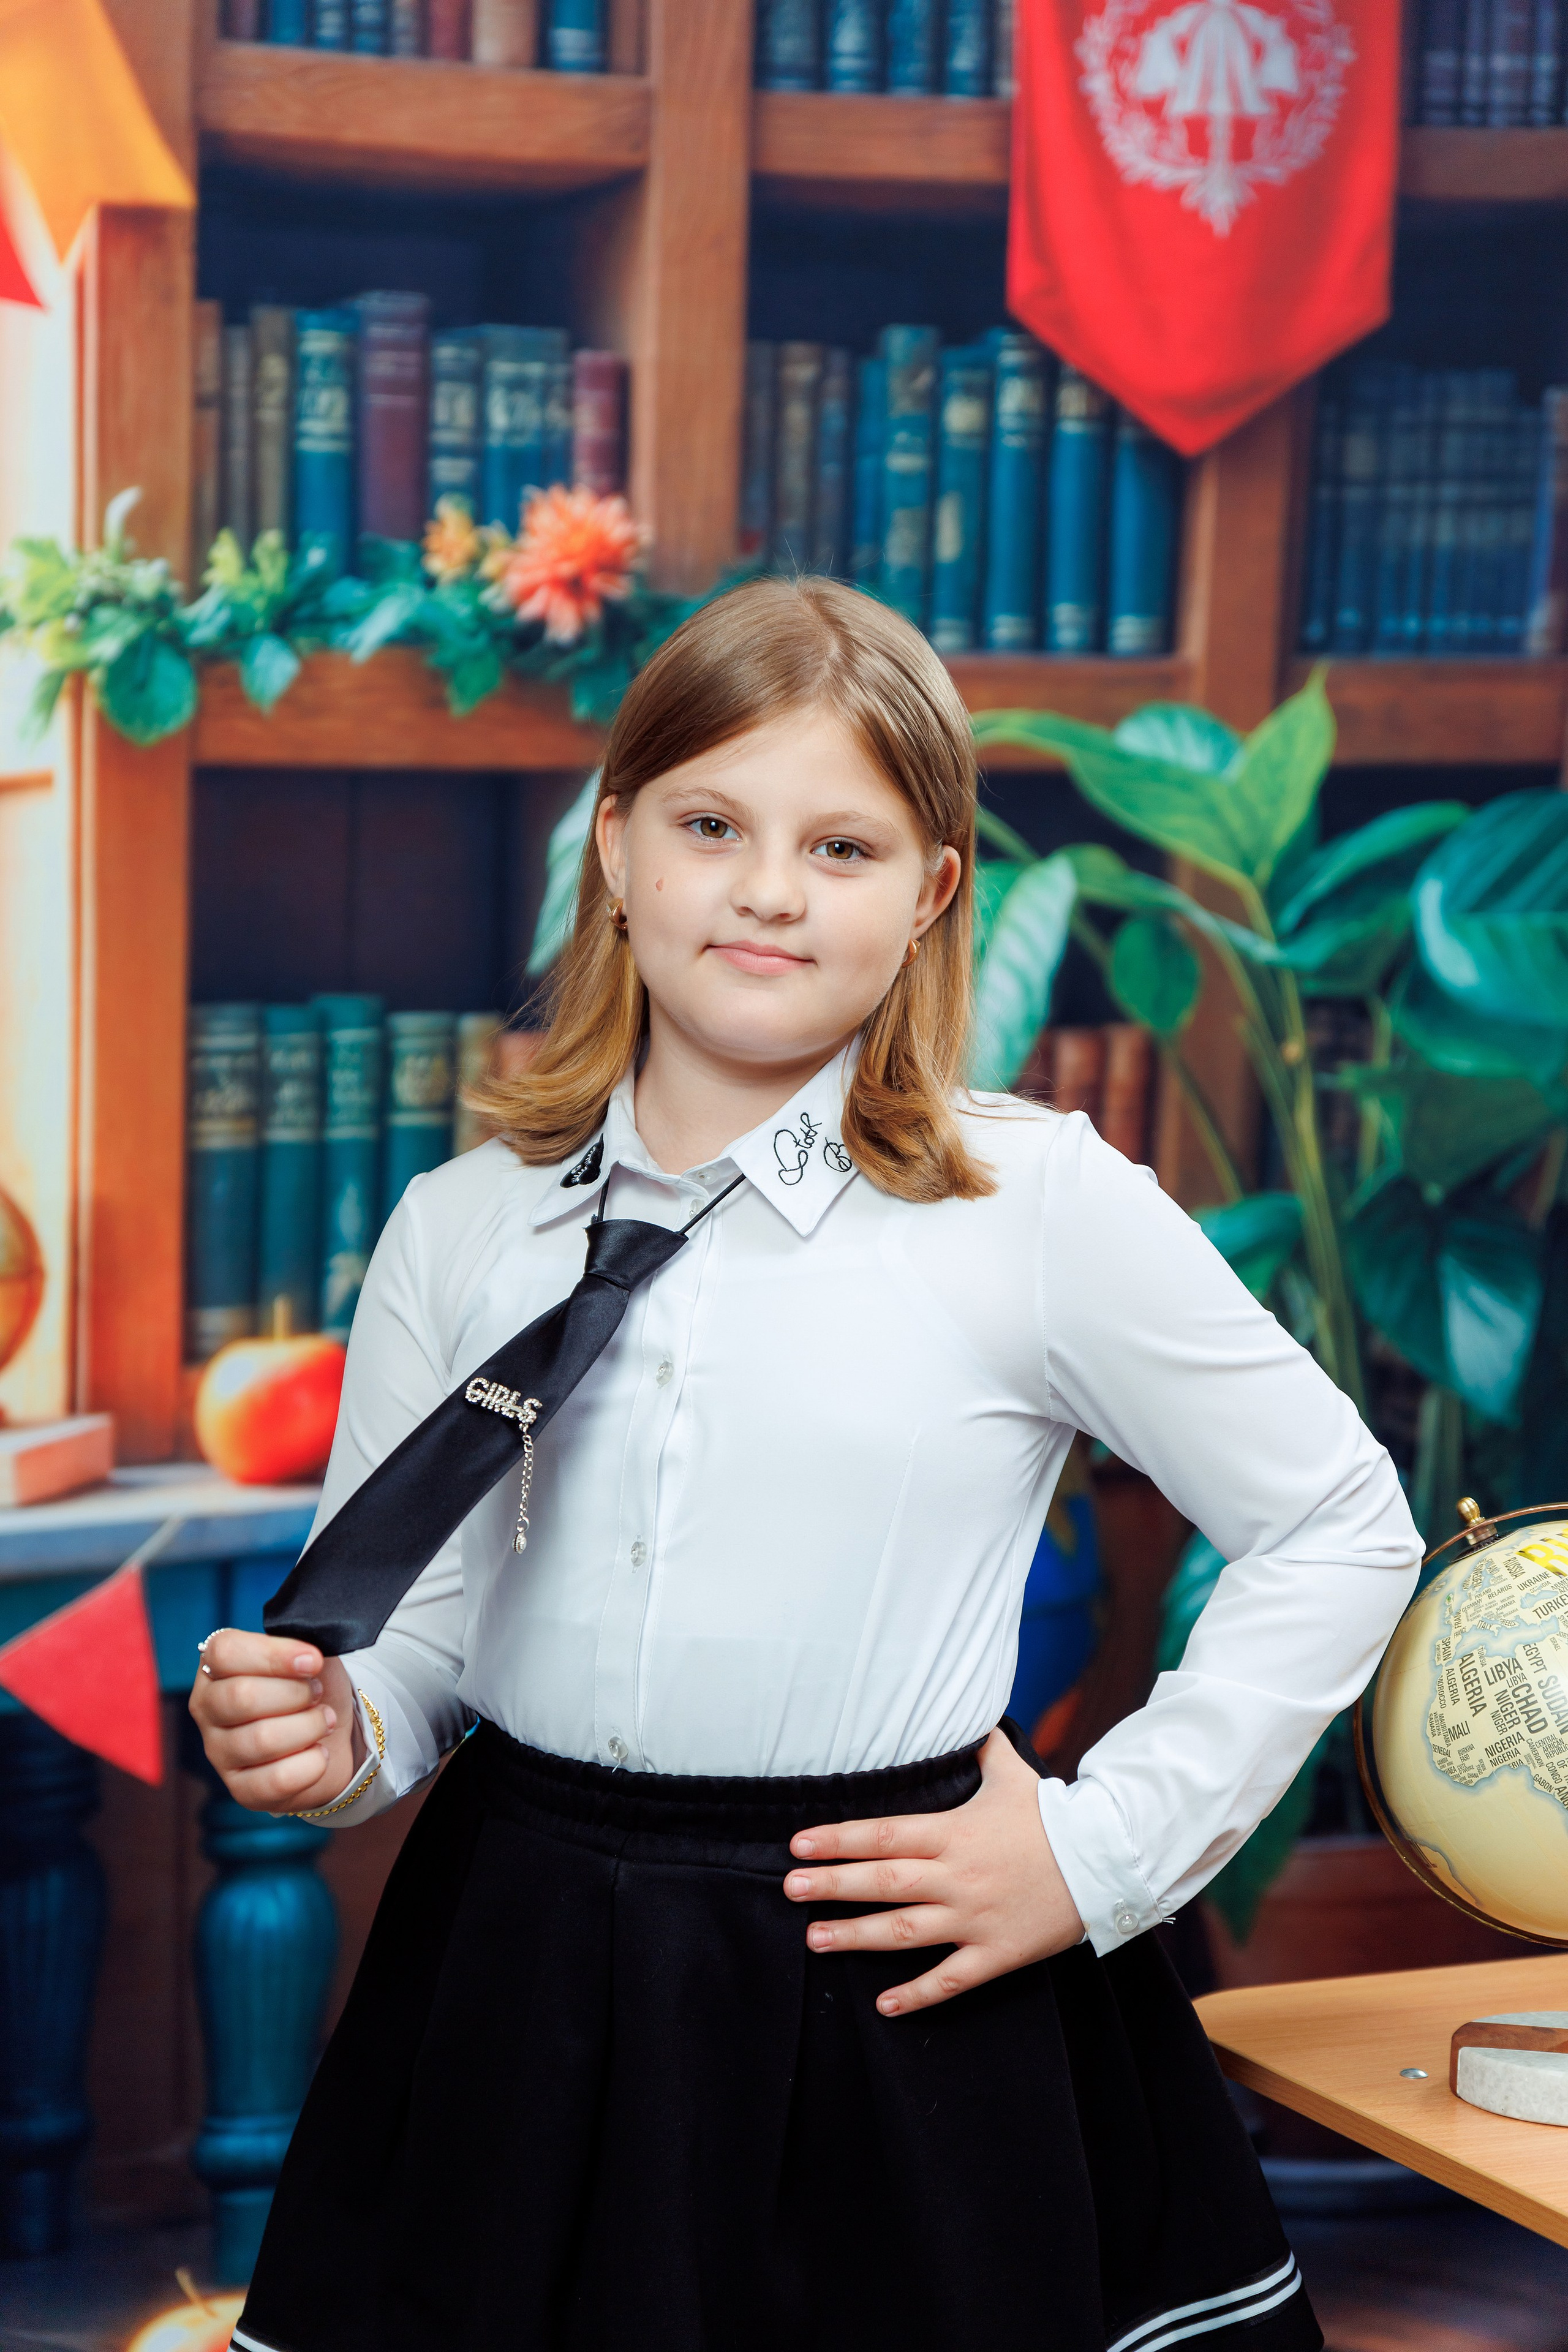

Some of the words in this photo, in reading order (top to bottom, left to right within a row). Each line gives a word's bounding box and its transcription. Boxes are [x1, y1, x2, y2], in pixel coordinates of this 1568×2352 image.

[1472, 1563, 1483, 1588] SWEDEN
[1502, 1556, 1526, 1580] RUSSIA
[1487, 1583, 1513, 1600] BELARUS
[1517, 1571, 1551, 1591] UKRAINE
[1529, 1580, 1551, 1594] GEGIA
[1474, 1588, 1492, 1600] POLAND
[1461, 1598, 1483, 1613] GERMANY
[1496, 1599, 1516, 1612] ROMANIA
[1442, 1637, 1452, 1662] SPAIN
[1550, 1637, 1561, 1651] ISRAEL
[1477, 1646, 1487, 1668] TUNISIA
[1523, 1643, 1548, 1674] EGYPT
[1483, 1657, 1524, 1686] LIBYA
[1506, 1672, 1528, 1688] LIBYA
[1446, 1668, 1460, 1706] ALGERIA
[1458, 1653, 1488, 1717] ALGERIA
[1494, 1689, 1521, 1730] NIGER
[1511, 1683, 1548, 1734] CHAD
[1433, 1711, 1442, 1736] WESTERN
[1438, 1713, 1452, 1748] MAURITANIA
[1447, 1721, 1471, 1742] MALI
[1490, 1709, 1508, 1735] NIGER
[1432, 1744, 1452, 1758] SENEGAL
[1457, 1743, 1476, 1757] BURKINA
[1484, 1731, 1526, 1758] NIGERIA
[1534, 1733, 1558, 1749] CENTRAL
[1542, 1738, 1565, 1754] AFRICAN
[1460, 1753, 1470, 1763] FASO
[1490, 1747, 1521, 1768] NIGERIA
[1526, 1738, 1545, 1768] CAMEROON
[1533, 1773, 1555, 1793] GABON
[1545, 1762, 1562, 1784] CONGO
